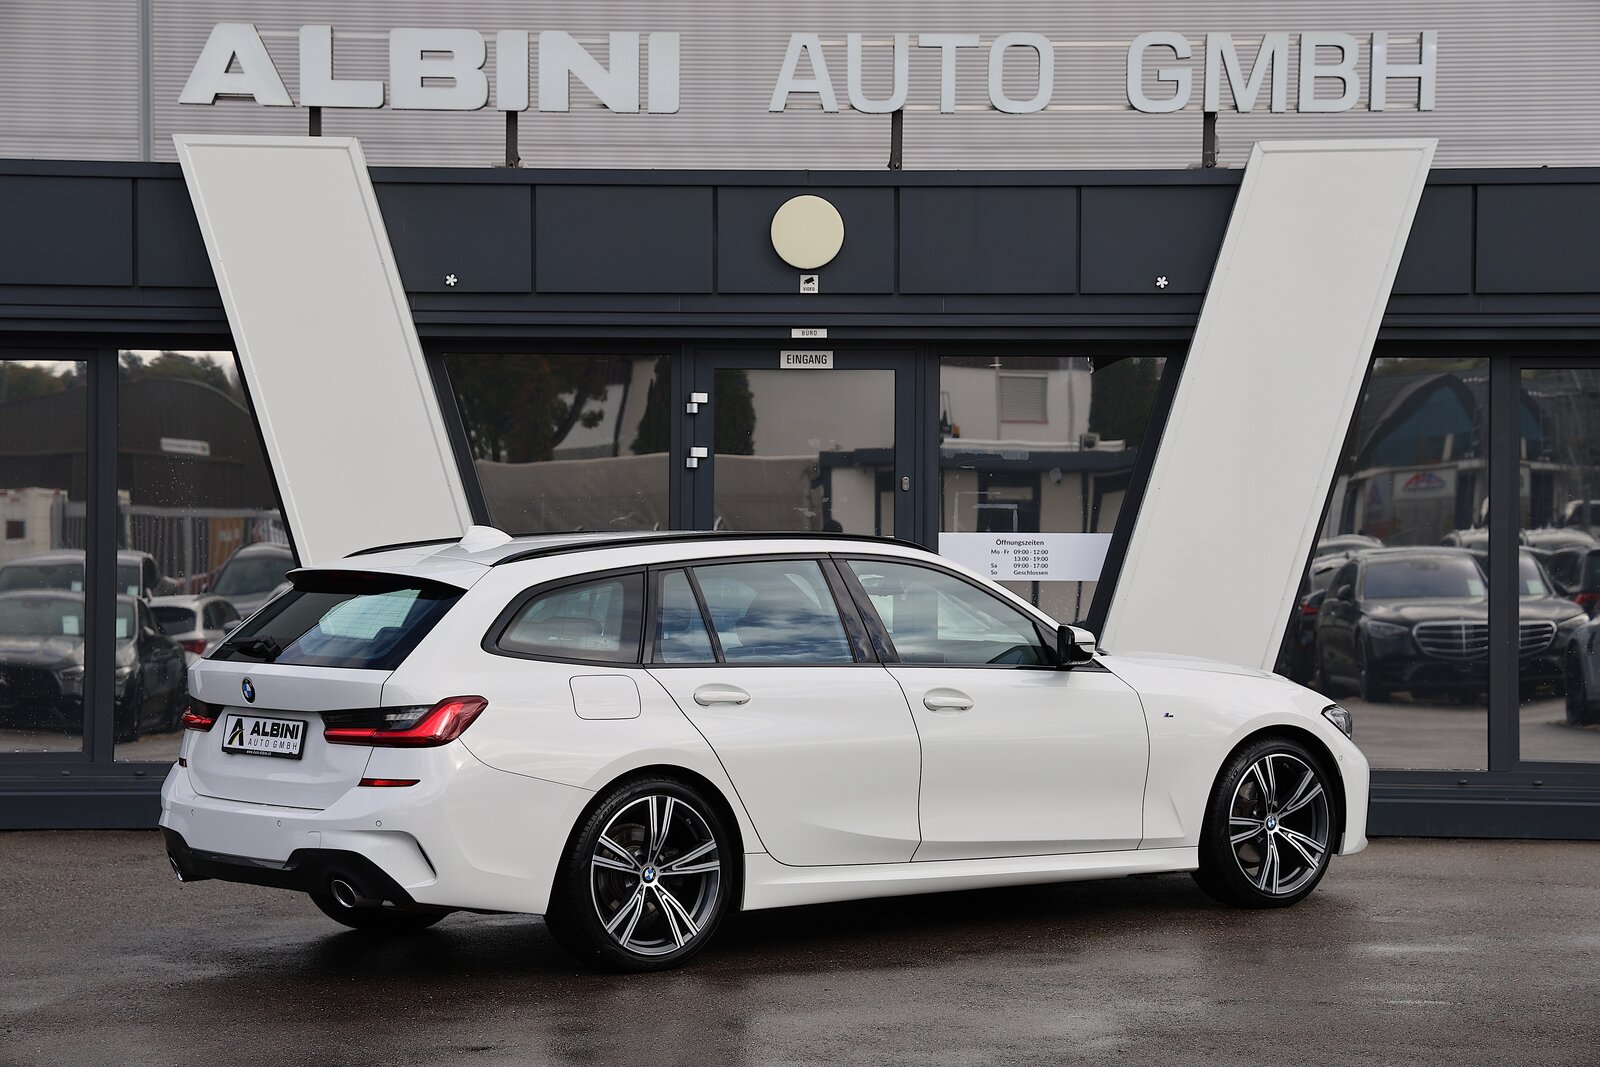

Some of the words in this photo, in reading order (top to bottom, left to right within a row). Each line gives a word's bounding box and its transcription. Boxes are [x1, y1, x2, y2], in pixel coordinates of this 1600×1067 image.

[178, 22, 681, 114] ALBINI
[768, 31, 1055, 114] AUTO
[1126, 30, 1439, 114] GMBH
[786, 354, 828, 365] EINGANG
[995, 539, 1045, 547] Öffnungszeiten
[250, 720, 300, 739] ALBINI
[247, 738, 270, 748] AUTO
[272, 740, 298, 751] GMBH
